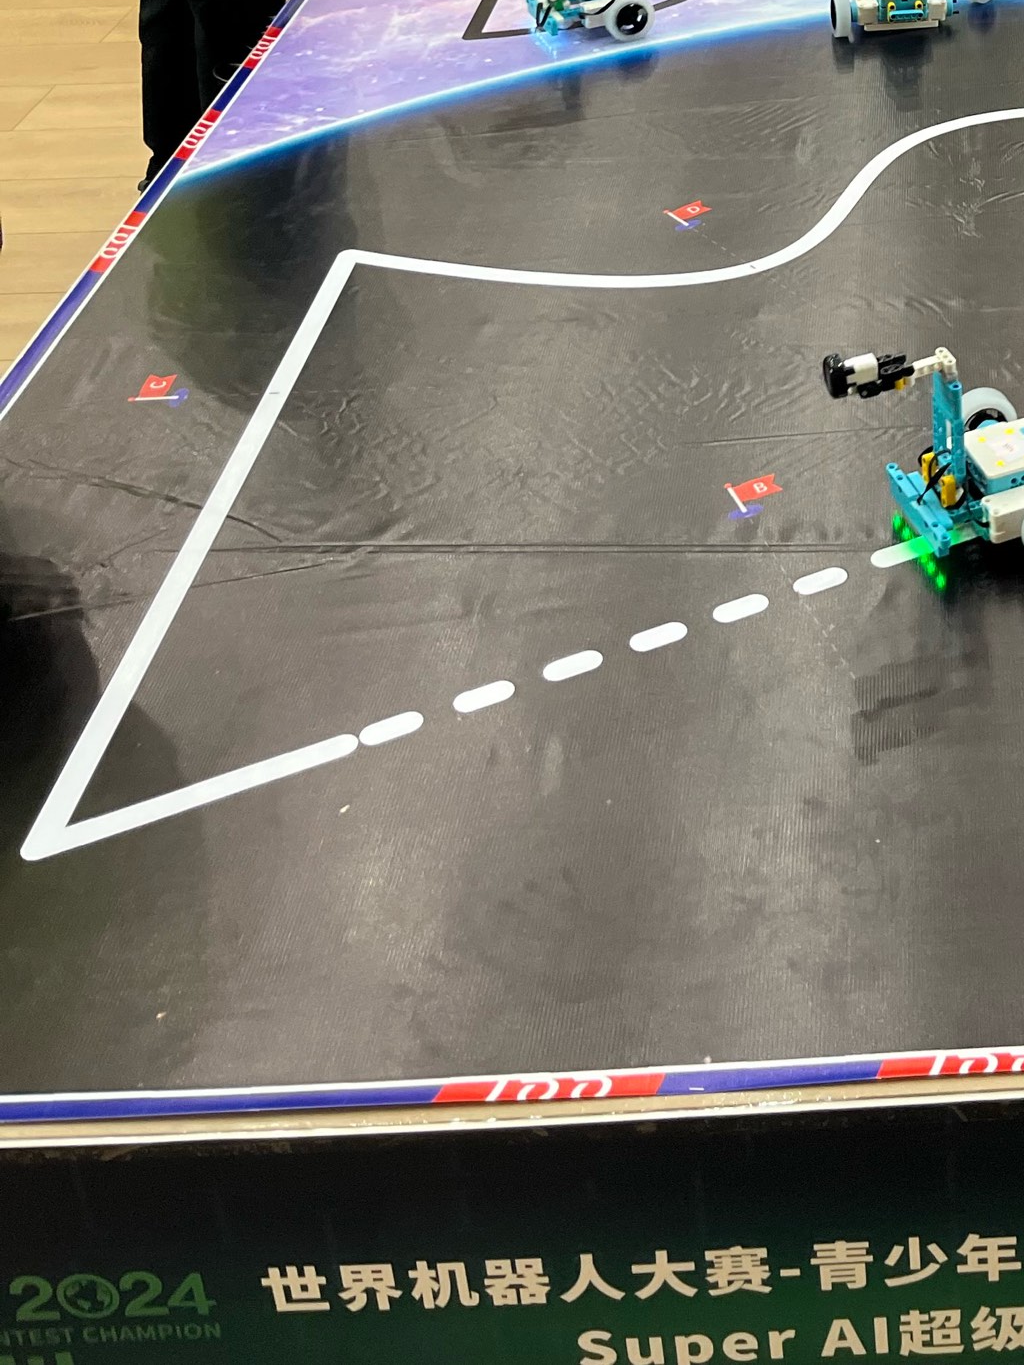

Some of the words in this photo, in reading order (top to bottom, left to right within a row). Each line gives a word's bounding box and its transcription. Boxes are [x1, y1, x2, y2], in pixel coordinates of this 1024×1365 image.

[99, 225, 140, 259] 100
[752, 481, 769, 494] B
[81, 1320, 223, 1344] CHAMPION
[579, 1325, 796, 1365] Super
